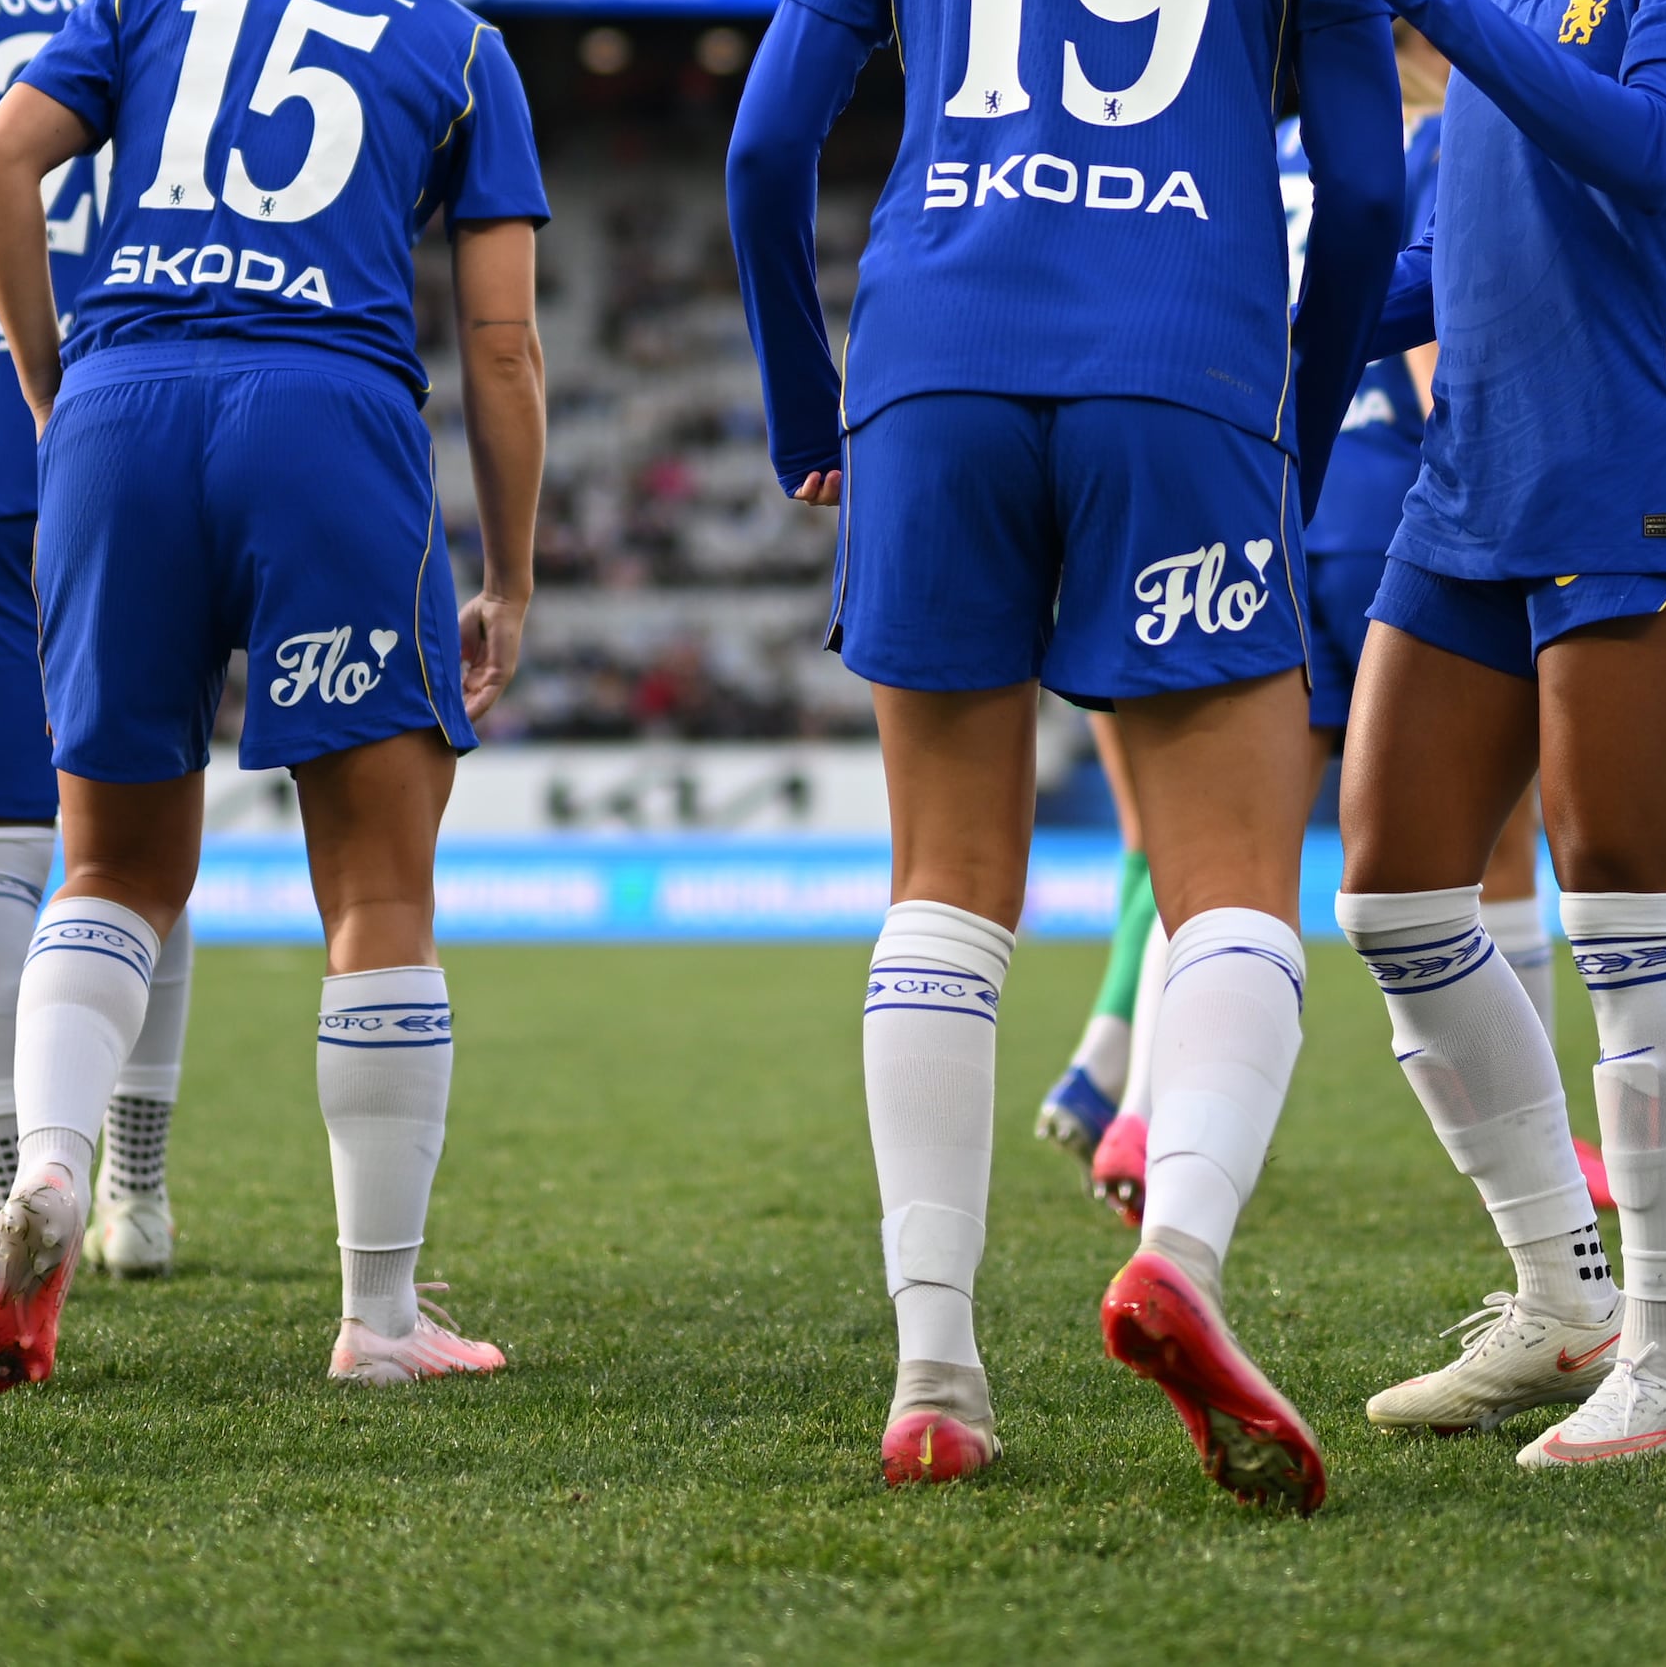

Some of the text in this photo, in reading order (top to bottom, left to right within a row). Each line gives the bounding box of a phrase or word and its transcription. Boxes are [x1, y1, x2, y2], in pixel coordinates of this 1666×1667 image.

[1134, 541, 1269, 646] Flo
[270, 625, 381, 708] Flo
[59, 927, 125, 948] CFC
[894, 979, 966, 998] CFC
[325, 1015, 383, 1031] CFC
